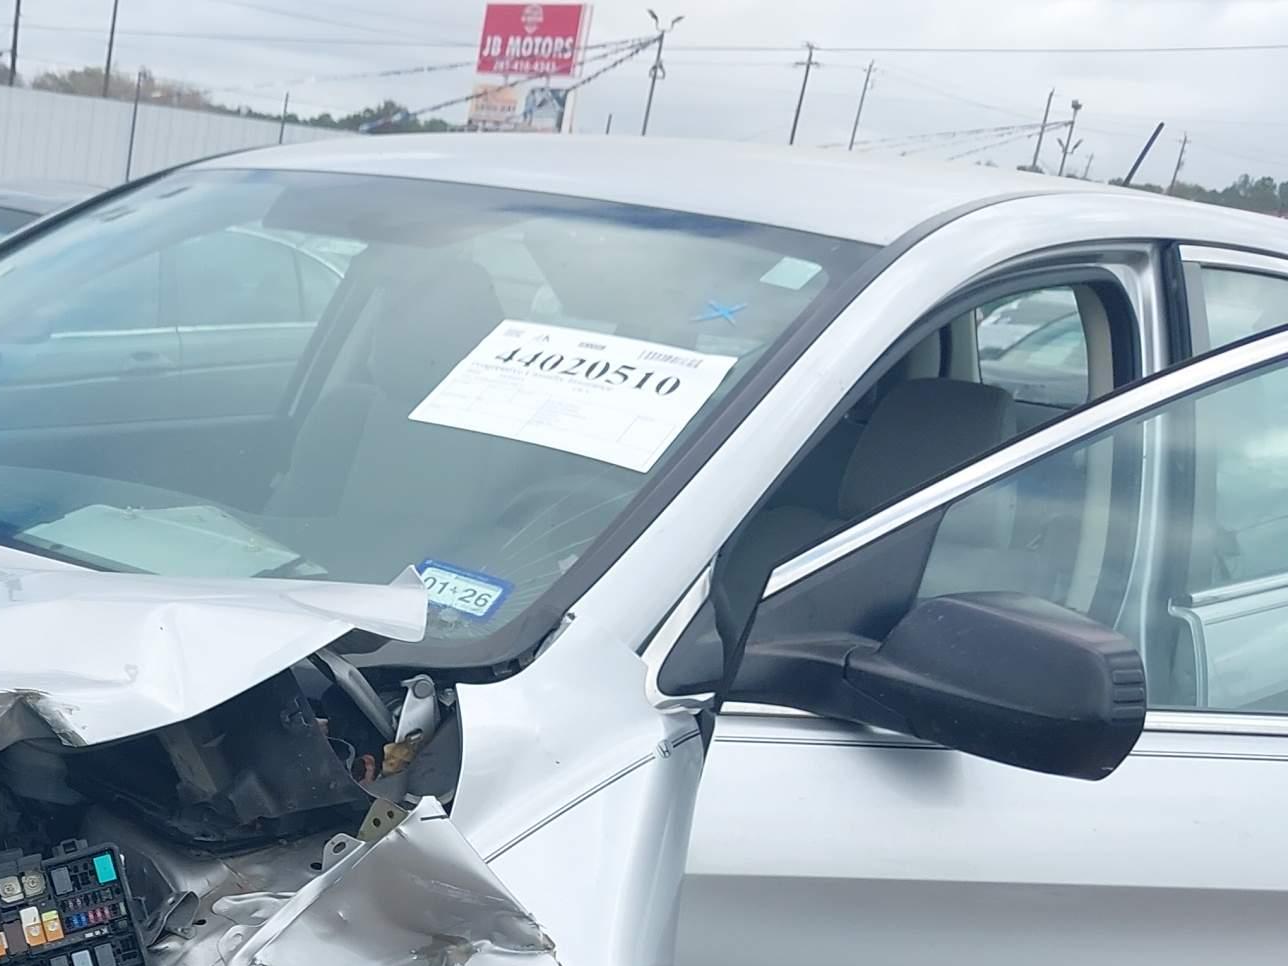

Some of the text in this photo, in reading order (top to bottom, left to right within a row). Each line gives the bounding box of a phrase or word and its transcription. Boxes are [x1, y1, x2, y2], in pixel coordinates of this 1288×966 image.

[482, 35, 573, 60] JB MOTORS
[495, 346, 682, 396] 44020510
[457, 588, 492, 608] 26
